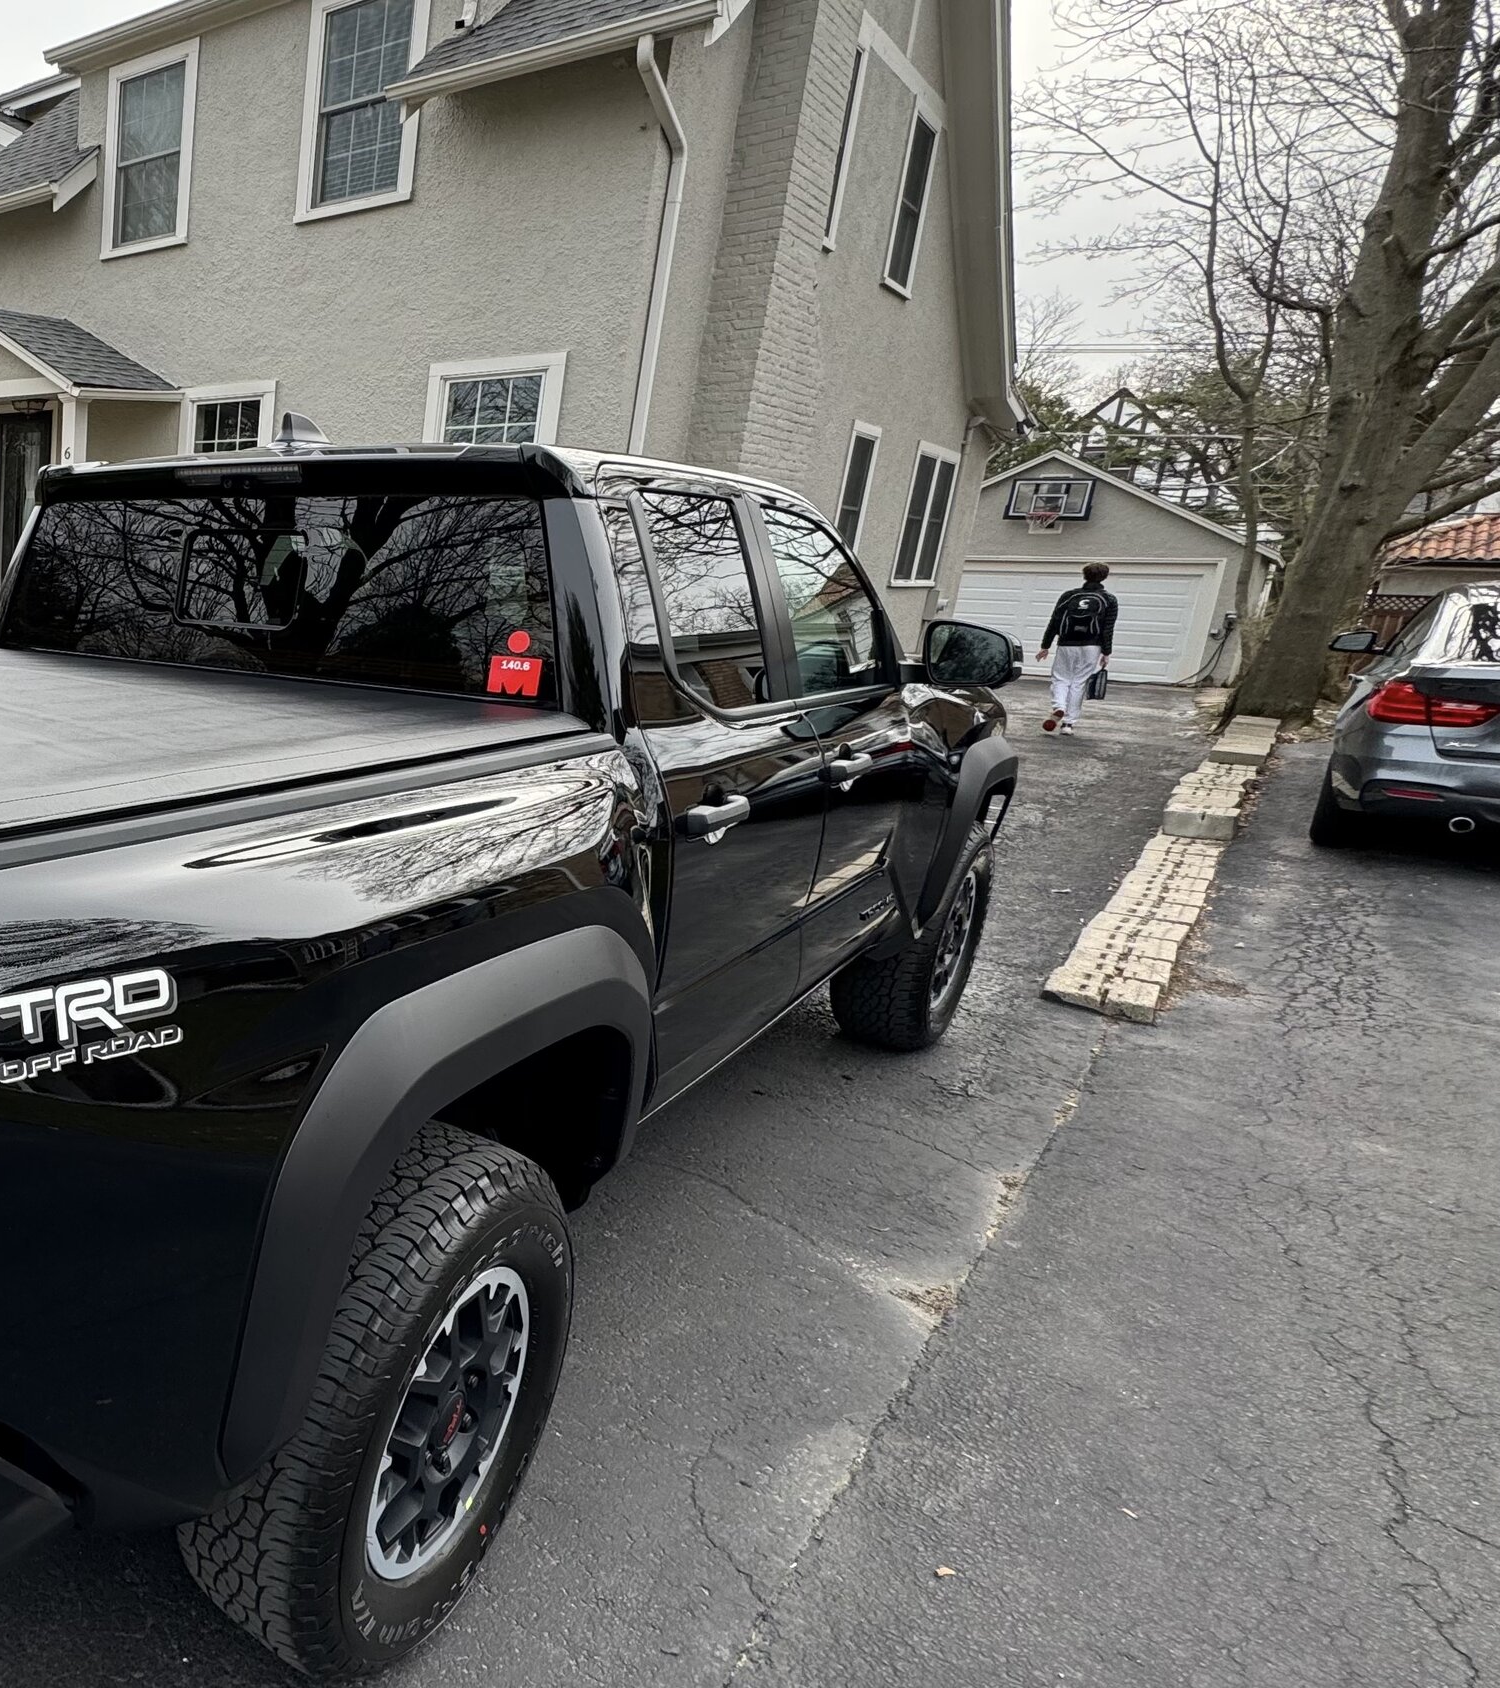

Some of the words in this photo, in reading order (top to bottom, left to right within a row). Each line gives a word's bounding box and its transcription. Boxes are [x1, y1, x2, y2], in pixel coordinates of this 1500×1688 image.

[64, 446, 71, 459] 6
[501, 660, 531, 671] 140.6
[81, 1024, 184, 1065] ROAD
